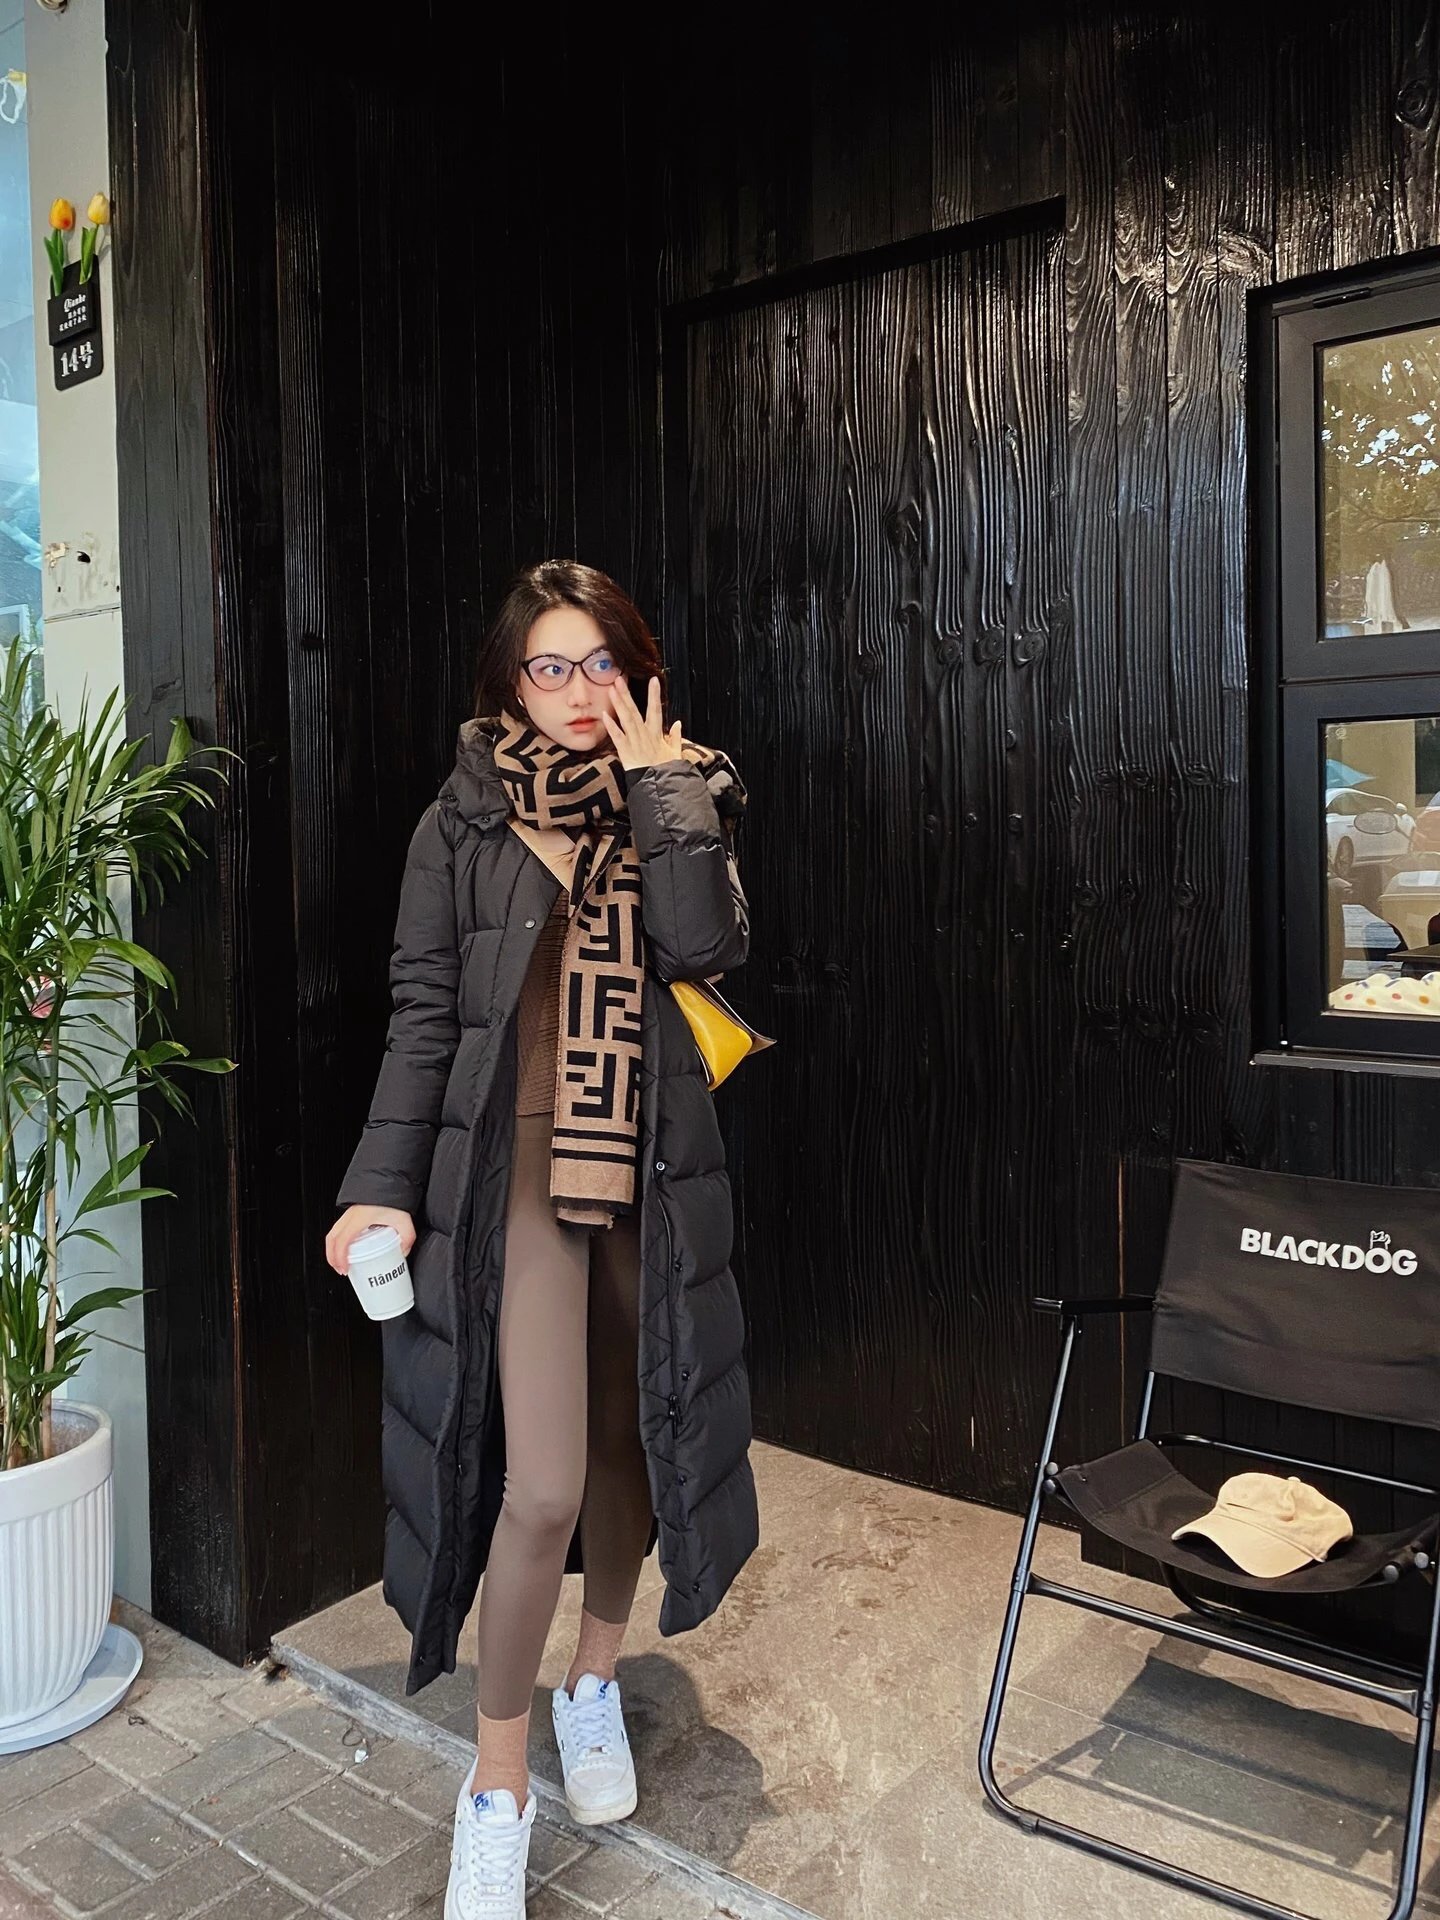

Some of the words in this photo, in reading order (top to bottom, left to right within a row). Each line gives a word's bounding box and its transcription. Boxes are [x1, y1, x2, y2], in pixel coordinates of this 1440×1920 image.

[60, 341, 94, 377] 14号
[1240, 1227, 1418, 1276] BLACKDOG
[367, 1262, 406, 1288] Flâneur
